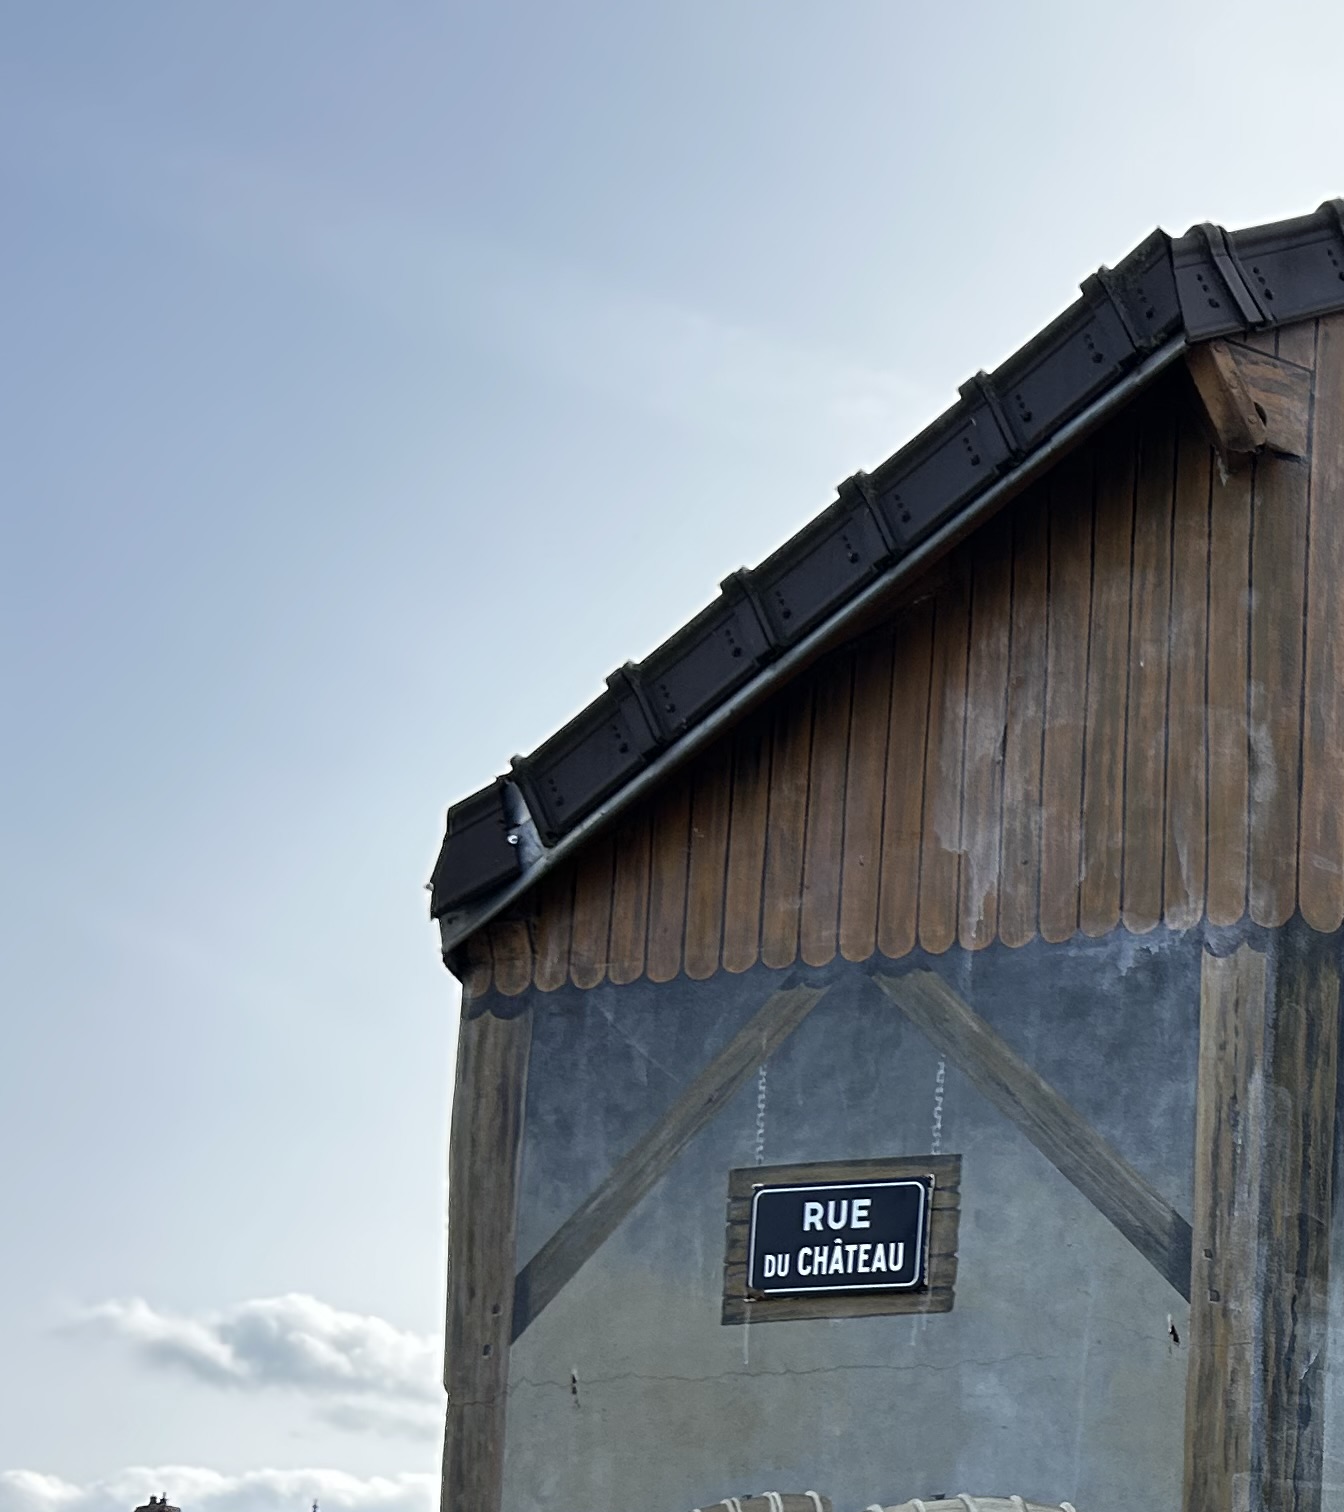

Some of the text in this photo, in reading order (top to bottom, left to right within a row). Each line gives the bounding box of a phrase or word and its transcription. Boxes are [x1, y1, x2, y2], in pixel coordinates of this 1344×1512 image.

[803, 1198, 872, 1231] RUE
[763, 1238, 904, 1278] DU CHÂTEAU
